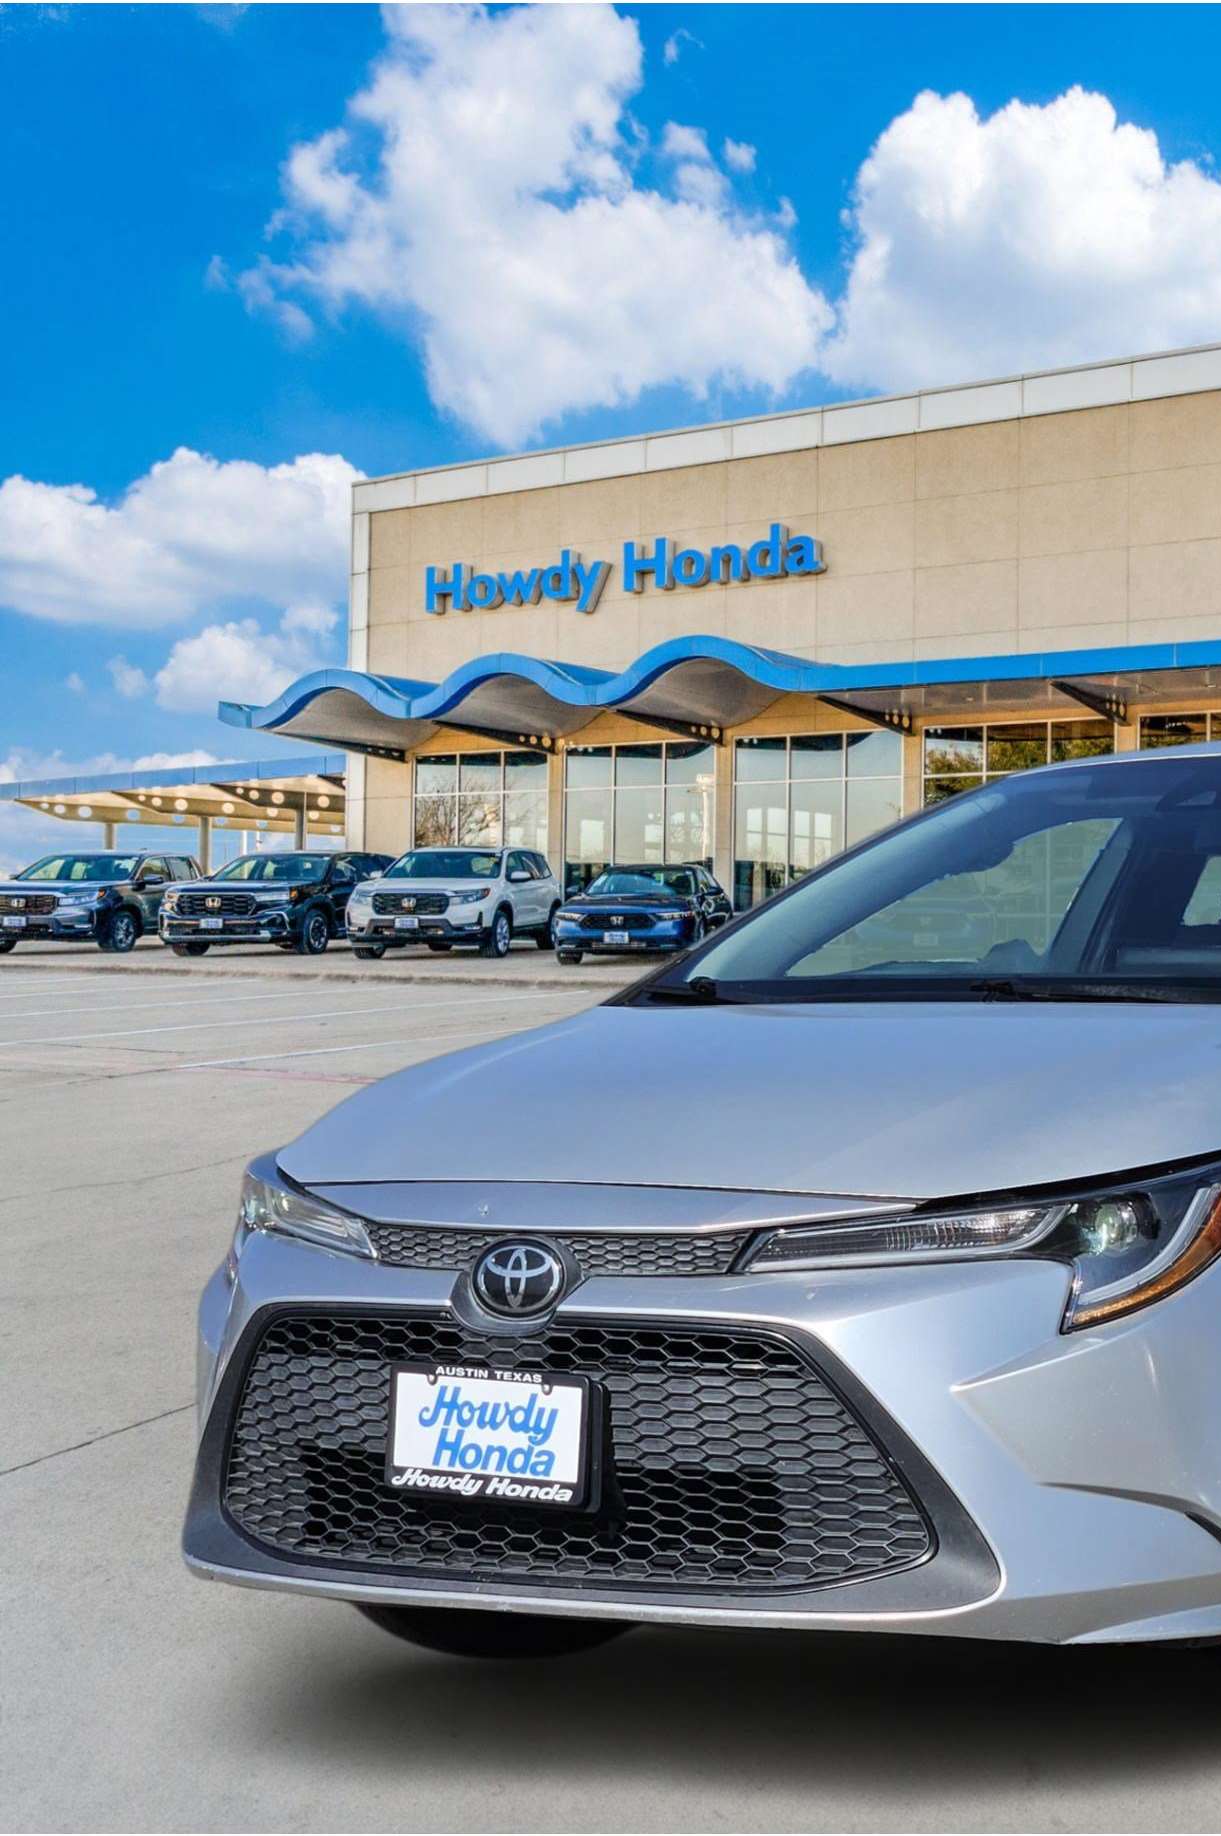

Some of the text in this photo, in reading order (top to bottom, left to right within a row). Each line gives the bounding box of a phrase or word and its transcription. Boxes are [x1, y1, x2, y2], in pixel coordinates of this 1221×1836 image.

[425, 522, 827, 615] Howdy Honda
[435, 1366, 542, 1384] AUSTIN TEXAS
[419, 1385, 559, 1446] Howdy
[432, 1427, 556, 1478] Honda
[391, 1468, 574, 1502] Howdy Honda
